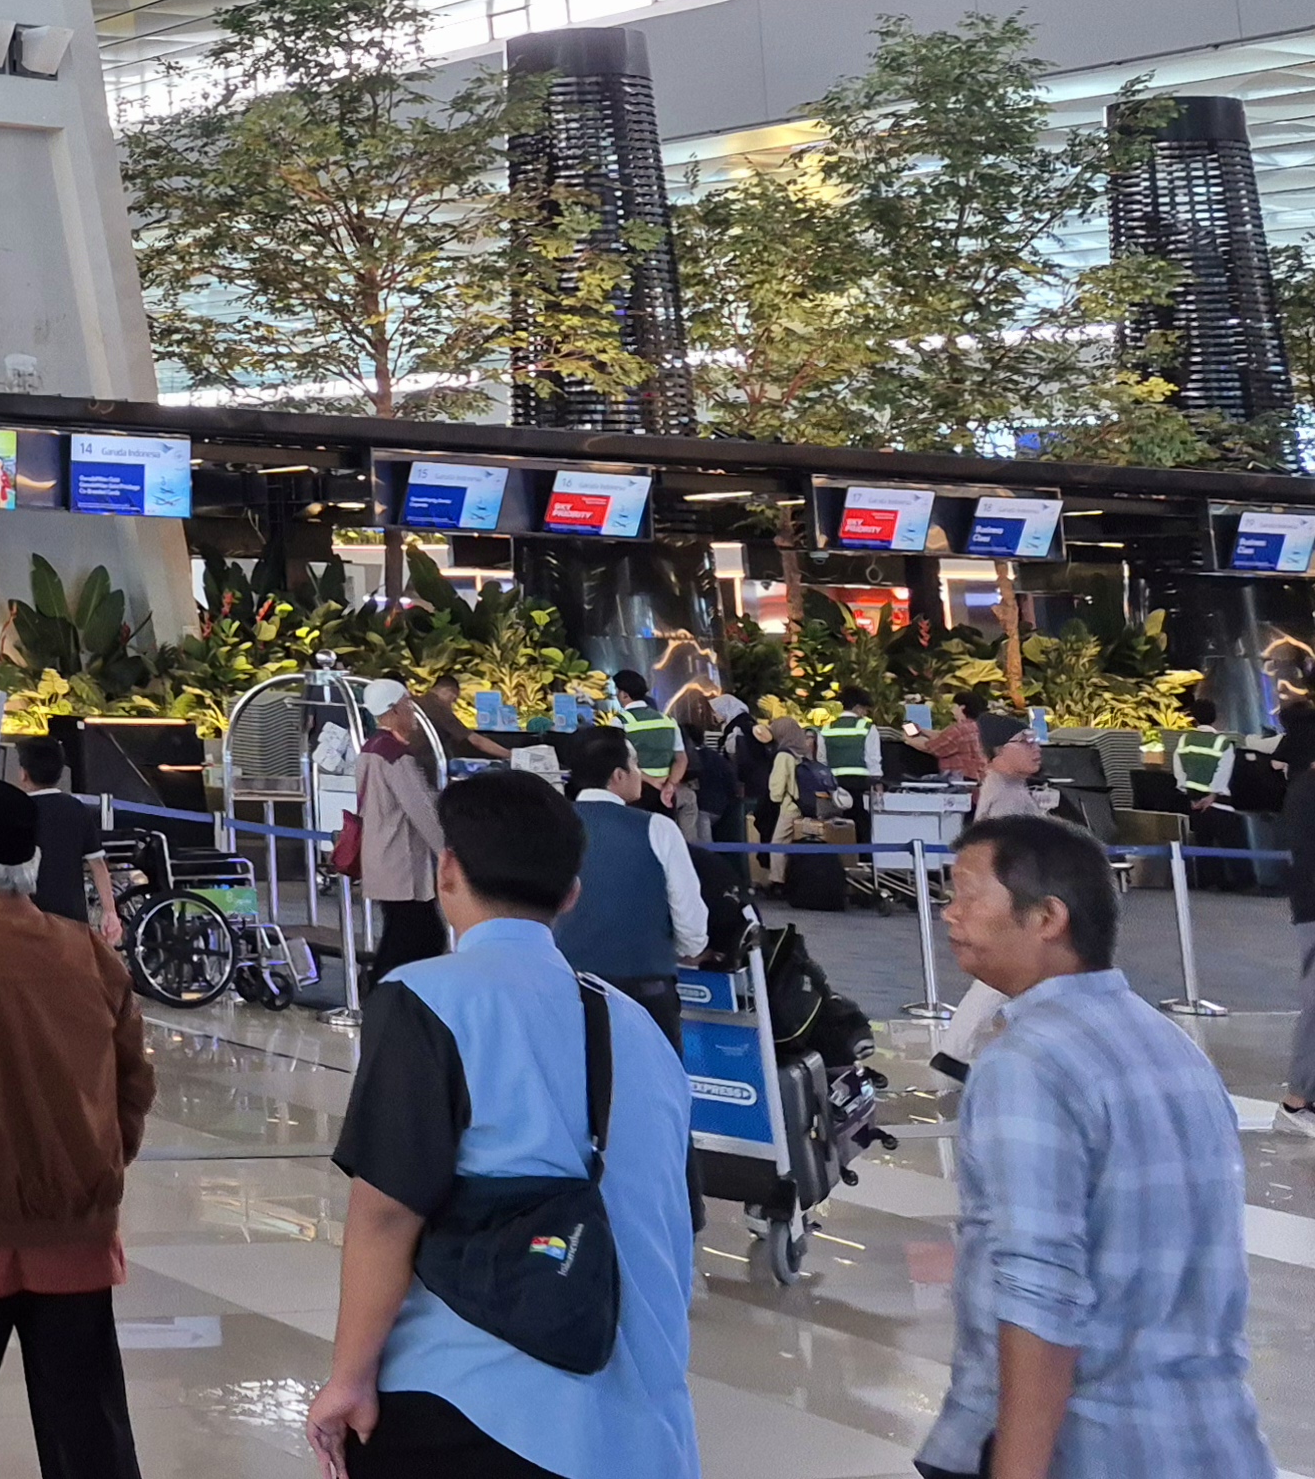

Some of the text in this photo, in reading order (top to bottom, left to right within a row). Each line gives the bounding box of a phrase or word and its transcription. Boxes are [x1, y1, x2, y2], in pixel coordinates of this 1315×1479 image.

[79, 442, 161, 459] 14 Garuda Indonesia
[417, 468, 429, 479] 15
[562, 478, 572, 487] 16
